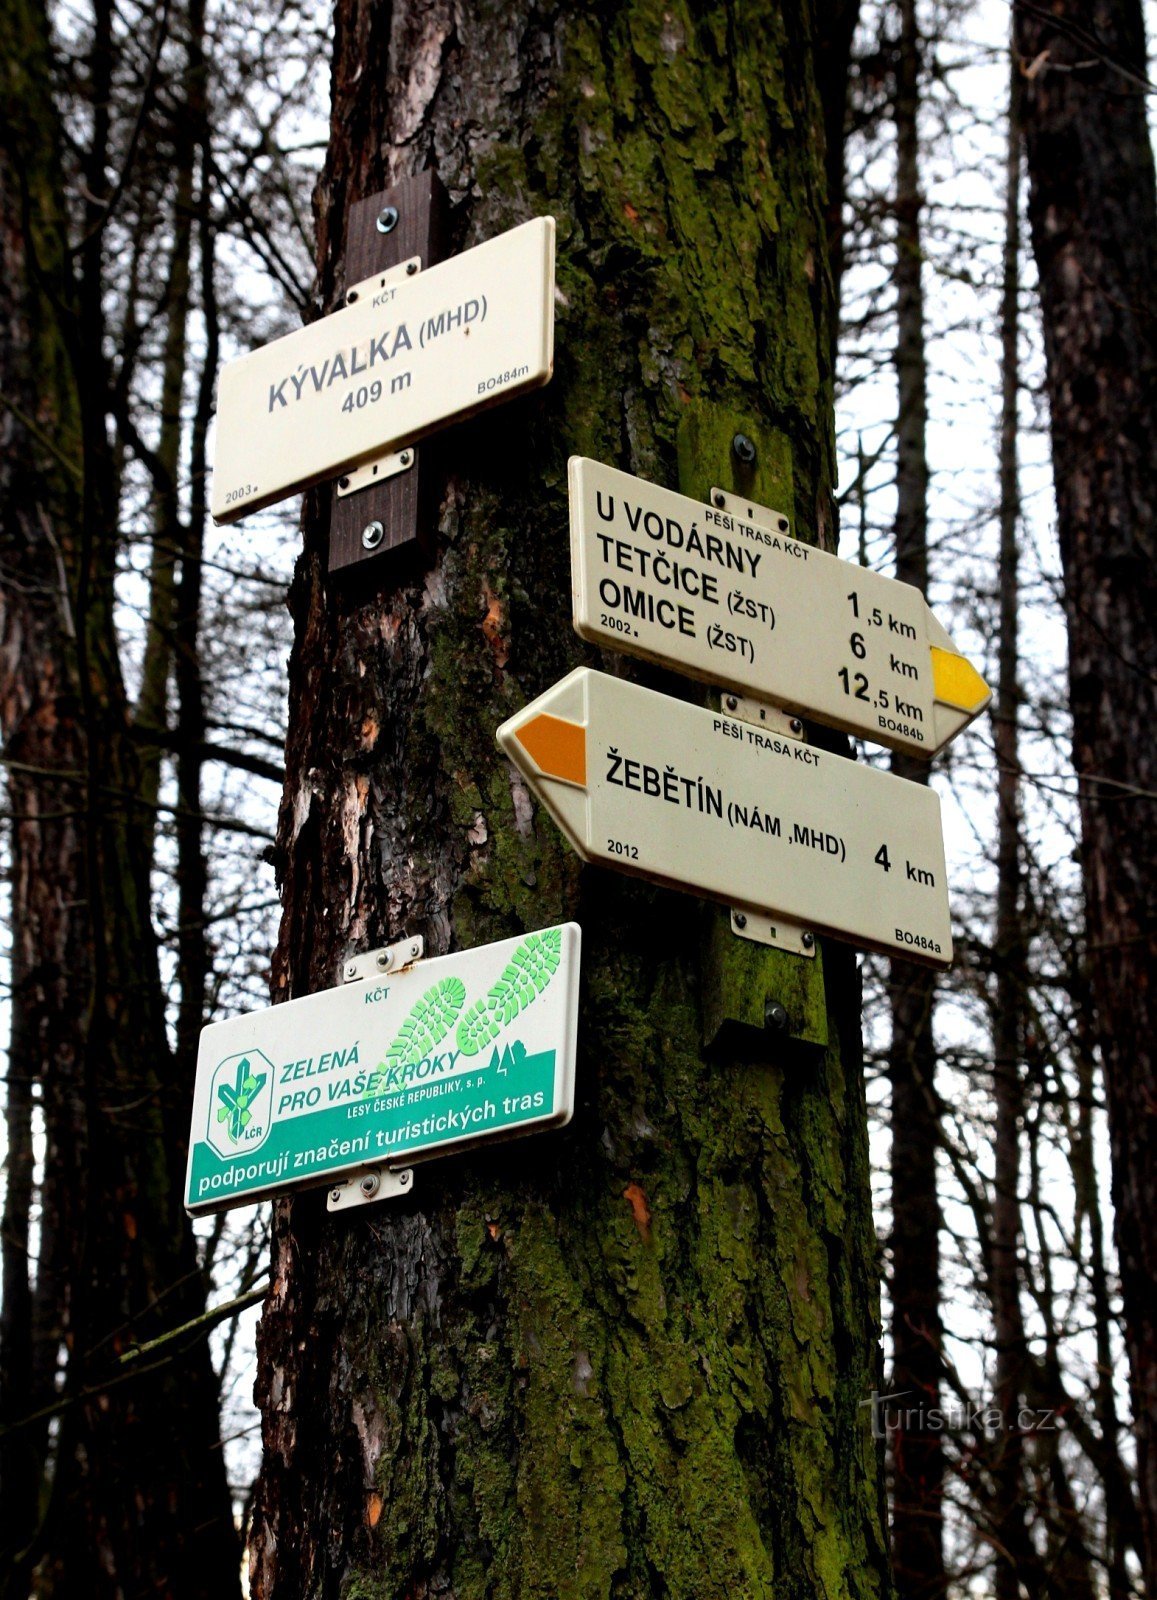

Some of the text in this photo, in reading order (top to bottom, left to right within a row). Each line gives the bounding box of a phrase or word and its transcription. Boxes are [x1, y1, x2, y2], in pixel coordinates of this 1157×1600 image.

[372, 288, 397, 309] KČT
[268, 295, 487, 412] KÝVALKA (MHD)
[341, 372, 412, 413] 409 m
[705, 510, 809, 560] PĚŠÍ TRASA KČT
[596, 491, 615, 522] U
[624, 502, 761, 578] VODÁRNY
[889, 613, 916, 640] km
[597, 533, 918, 680] TETČICE (ŽST) 6 km
[599, 578, 696, 637] OMICE
[707, 624, 755, 664] (ŽST)
[895, 695, 923, 722] km
[713, 719, 820, 767] PĚŠÍ TRASA KČT
[878, 715, 924, 741] BO484b
[606, 747, 724, 819] ŽEBĚTÍN
[874, 844, 891, 872] 4
[906, 860, 935, 887] km
[607, 839, 639, 860] 2012
[895, 928, 941, 954] BO484a
[365, 986, 391, 1005] KČT
[278, 1049, 462, 1115] PRO VAŠE KROKY
[279, 1041, 360, 1084] ZELENÁ
[347, 1076, 486, 1119] LESY ČESKÉ REPUBLIKY, s. p.
[199, 1091, 544, 1196] podporují značení turistických tras
[244, 1125, 262, 1140] LČR
